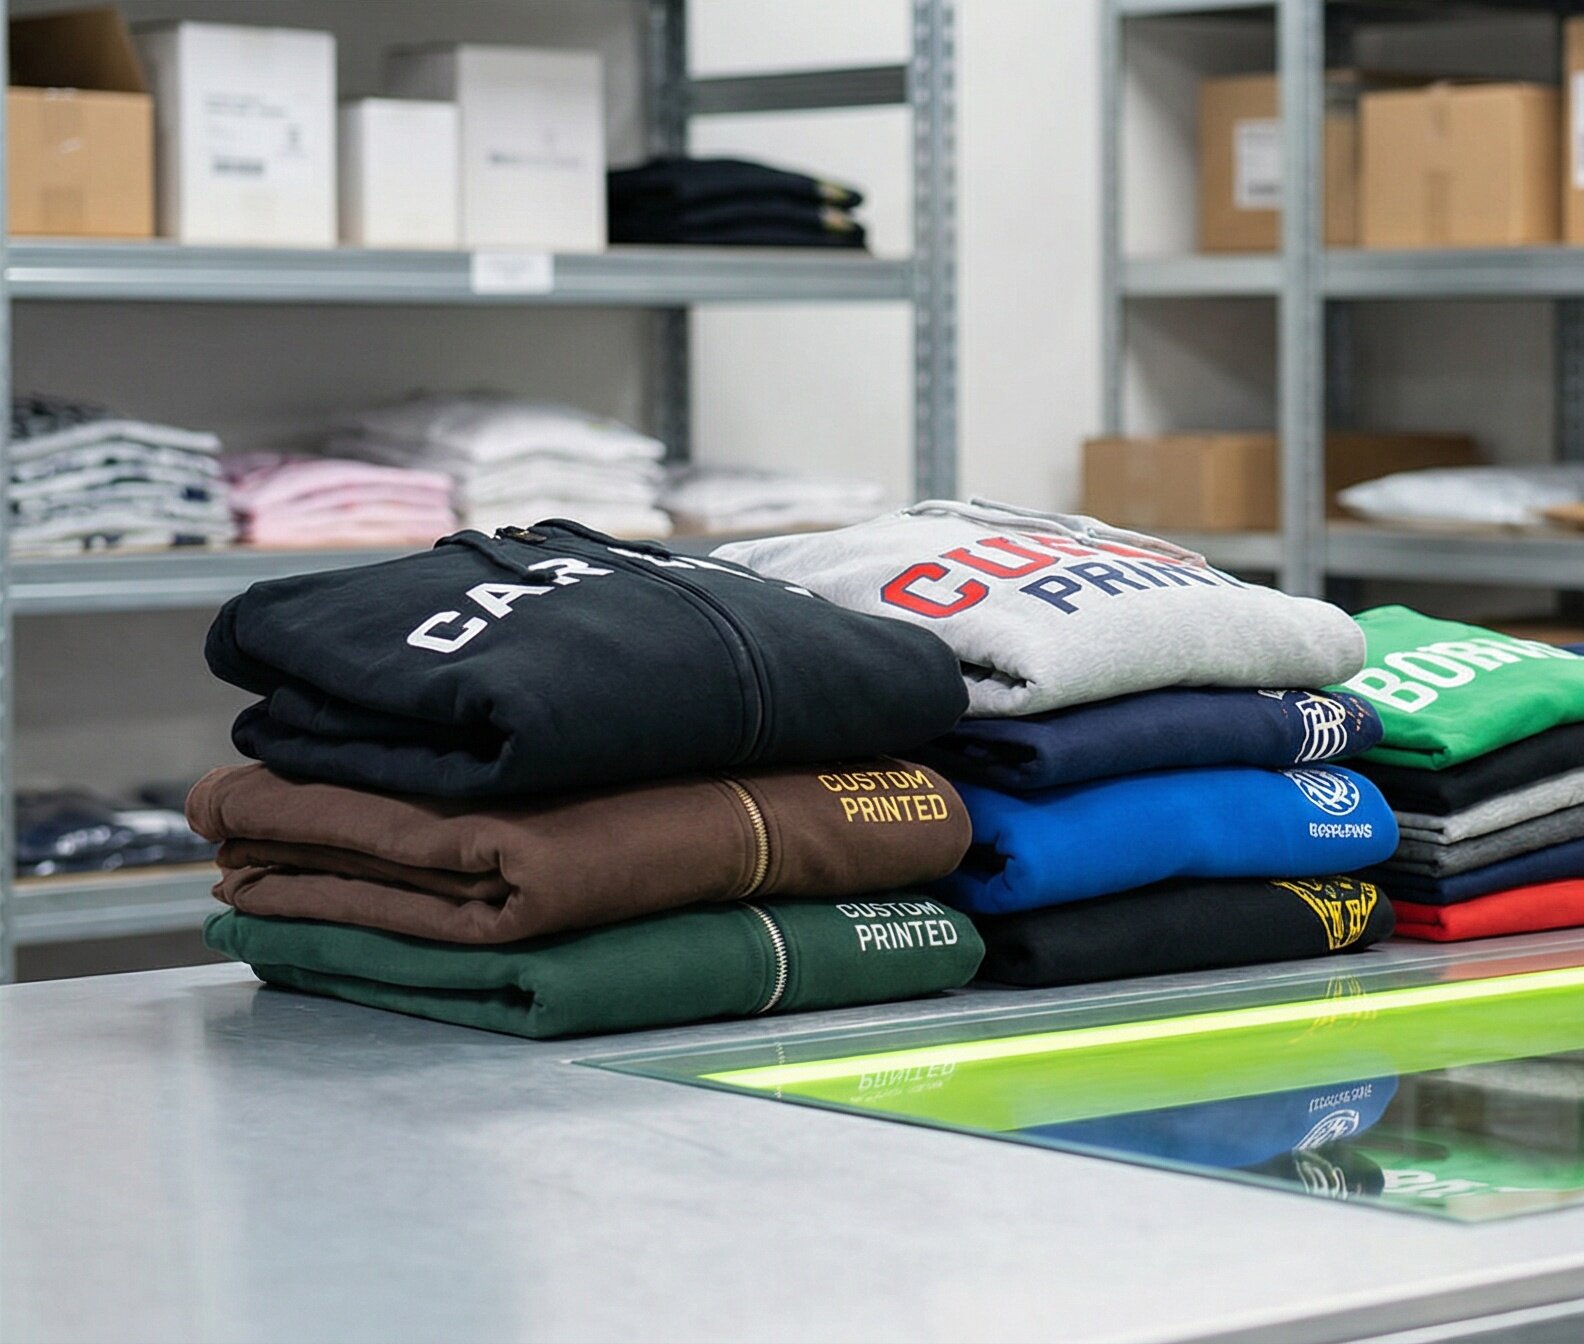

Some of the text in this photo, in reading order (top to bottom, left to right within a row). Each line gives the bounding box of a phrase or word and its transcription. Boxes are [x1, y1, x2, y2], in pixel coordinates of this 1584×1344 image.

[1019, 558, 1248, 615] PRIN
[818, 769, 935, 792] CUSTOM
[840, 794, 949, 823] PRINTED
[835, 901, 945, 919] CUSTOM
[854, 919, 958, 952] PRINTED
